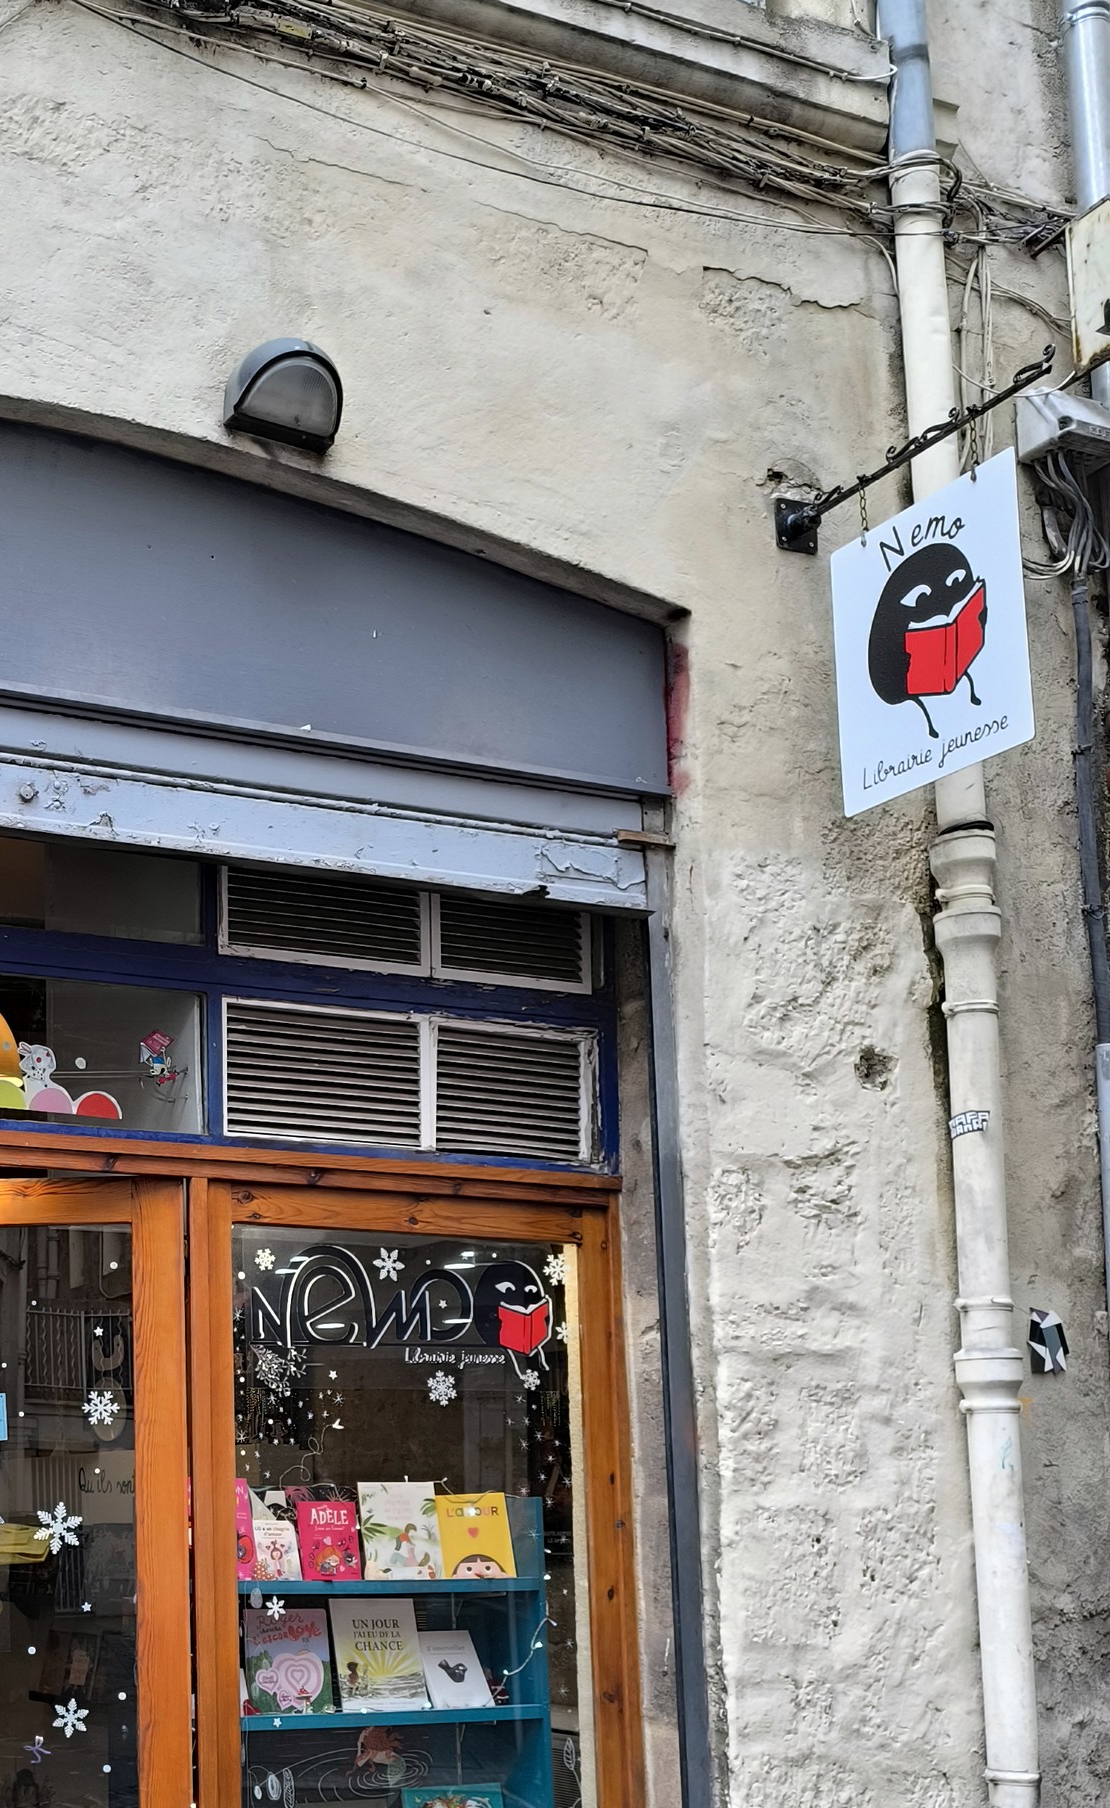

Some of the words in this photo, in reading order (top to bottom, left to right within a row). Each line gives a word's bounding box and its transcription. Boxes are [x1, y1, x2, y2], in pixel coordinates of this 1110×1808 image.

[879, 515, 966, 572] Nemo
[862, 742, 933, 791] Librairie
[938, 714, 1009, 768] jeunesse
[310, 1507, 349, 1525] ADÈLE
[352, 1619, 369, 1629] UN
[371, 1619, 400, 1630] JOUR
[355, 1641, 404, 1651] CHANCE
